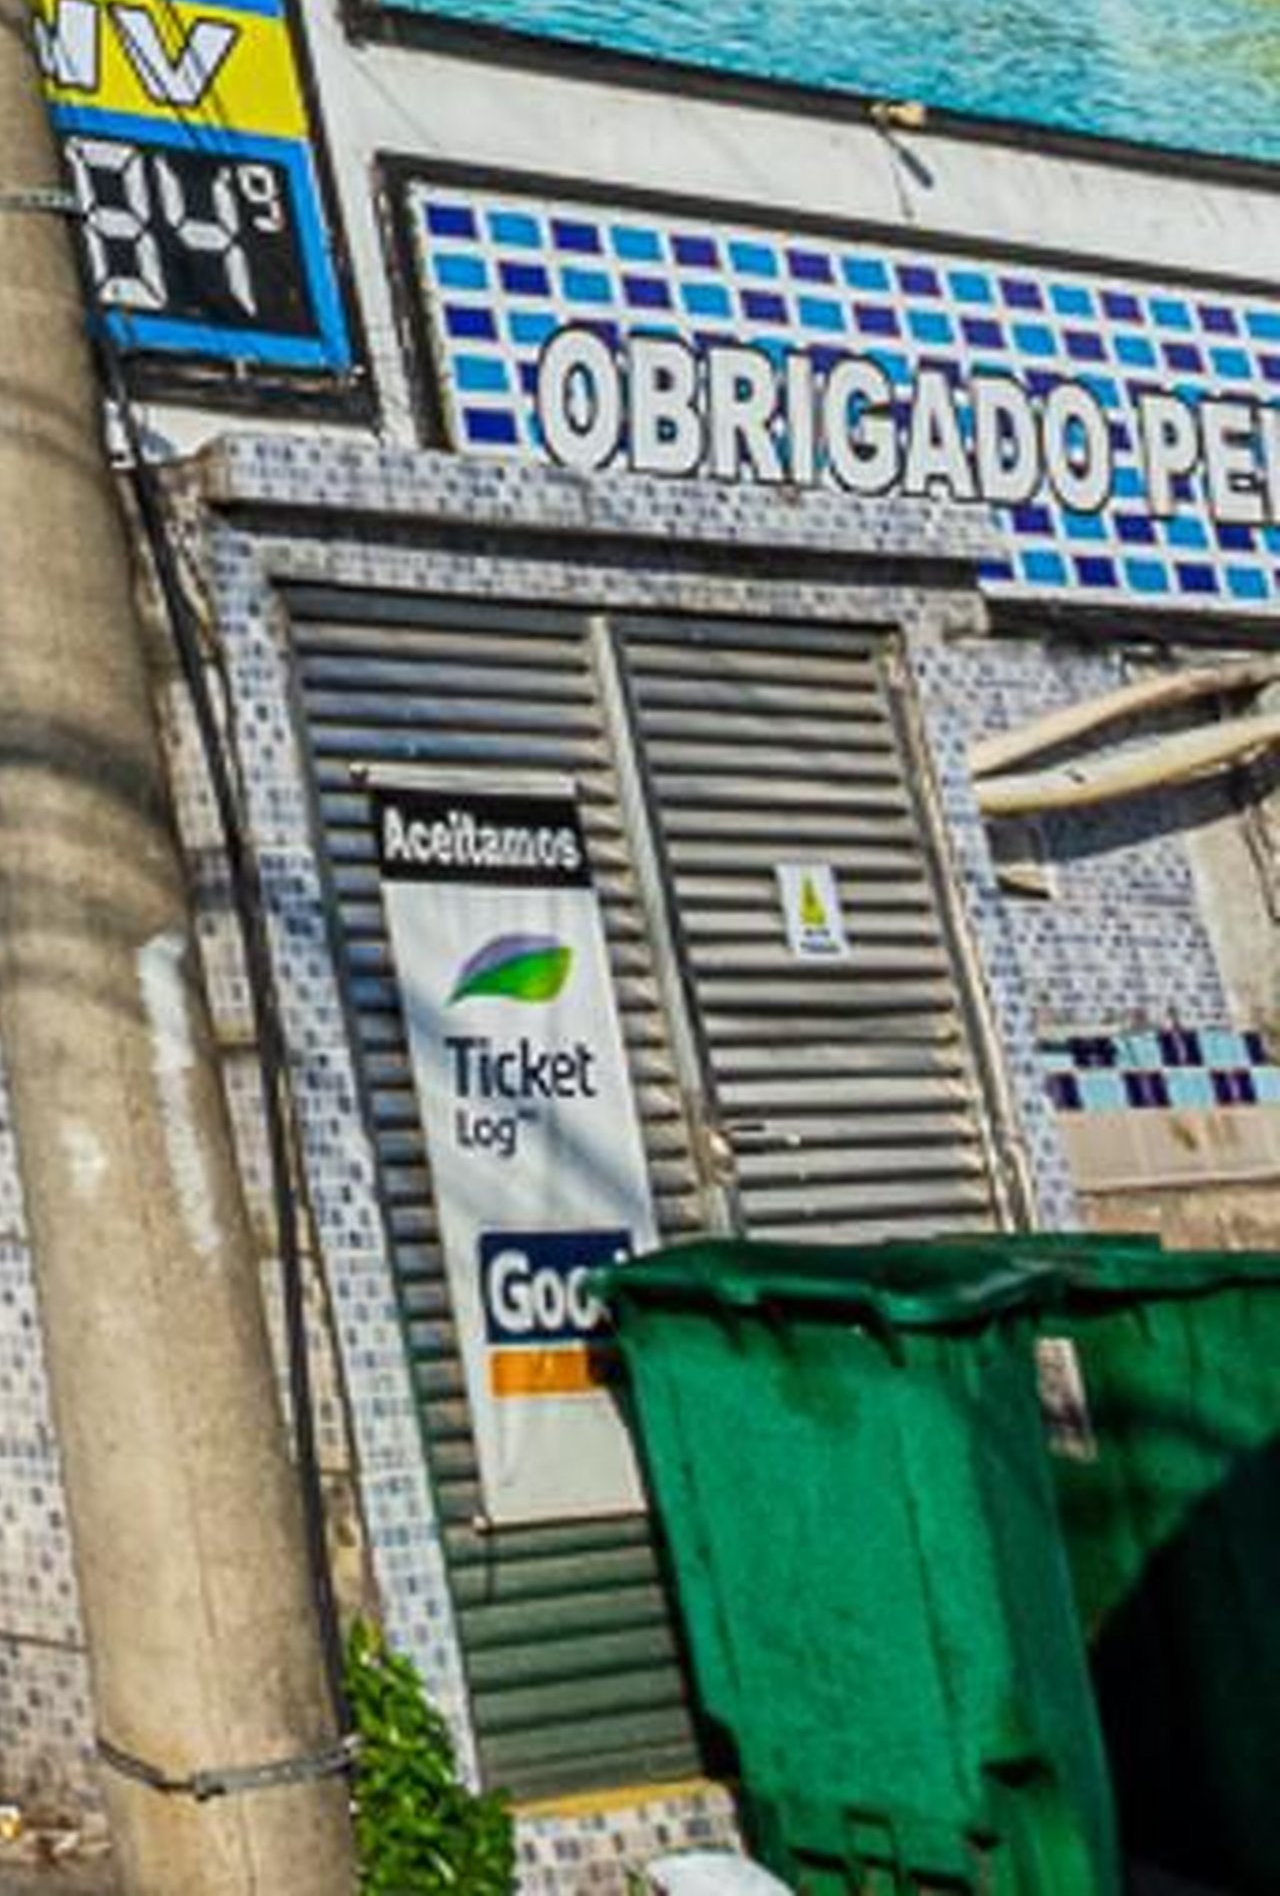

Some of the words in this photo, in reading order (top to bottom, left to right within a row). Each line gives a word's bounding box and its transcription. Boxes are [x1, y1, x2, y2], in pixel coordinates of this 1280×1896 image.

[536, 325, 1113, 513] OBRIGADO
[383, 806, 582, 871] Aceitamos
[444, 1034, 598, 1098] Ticket
